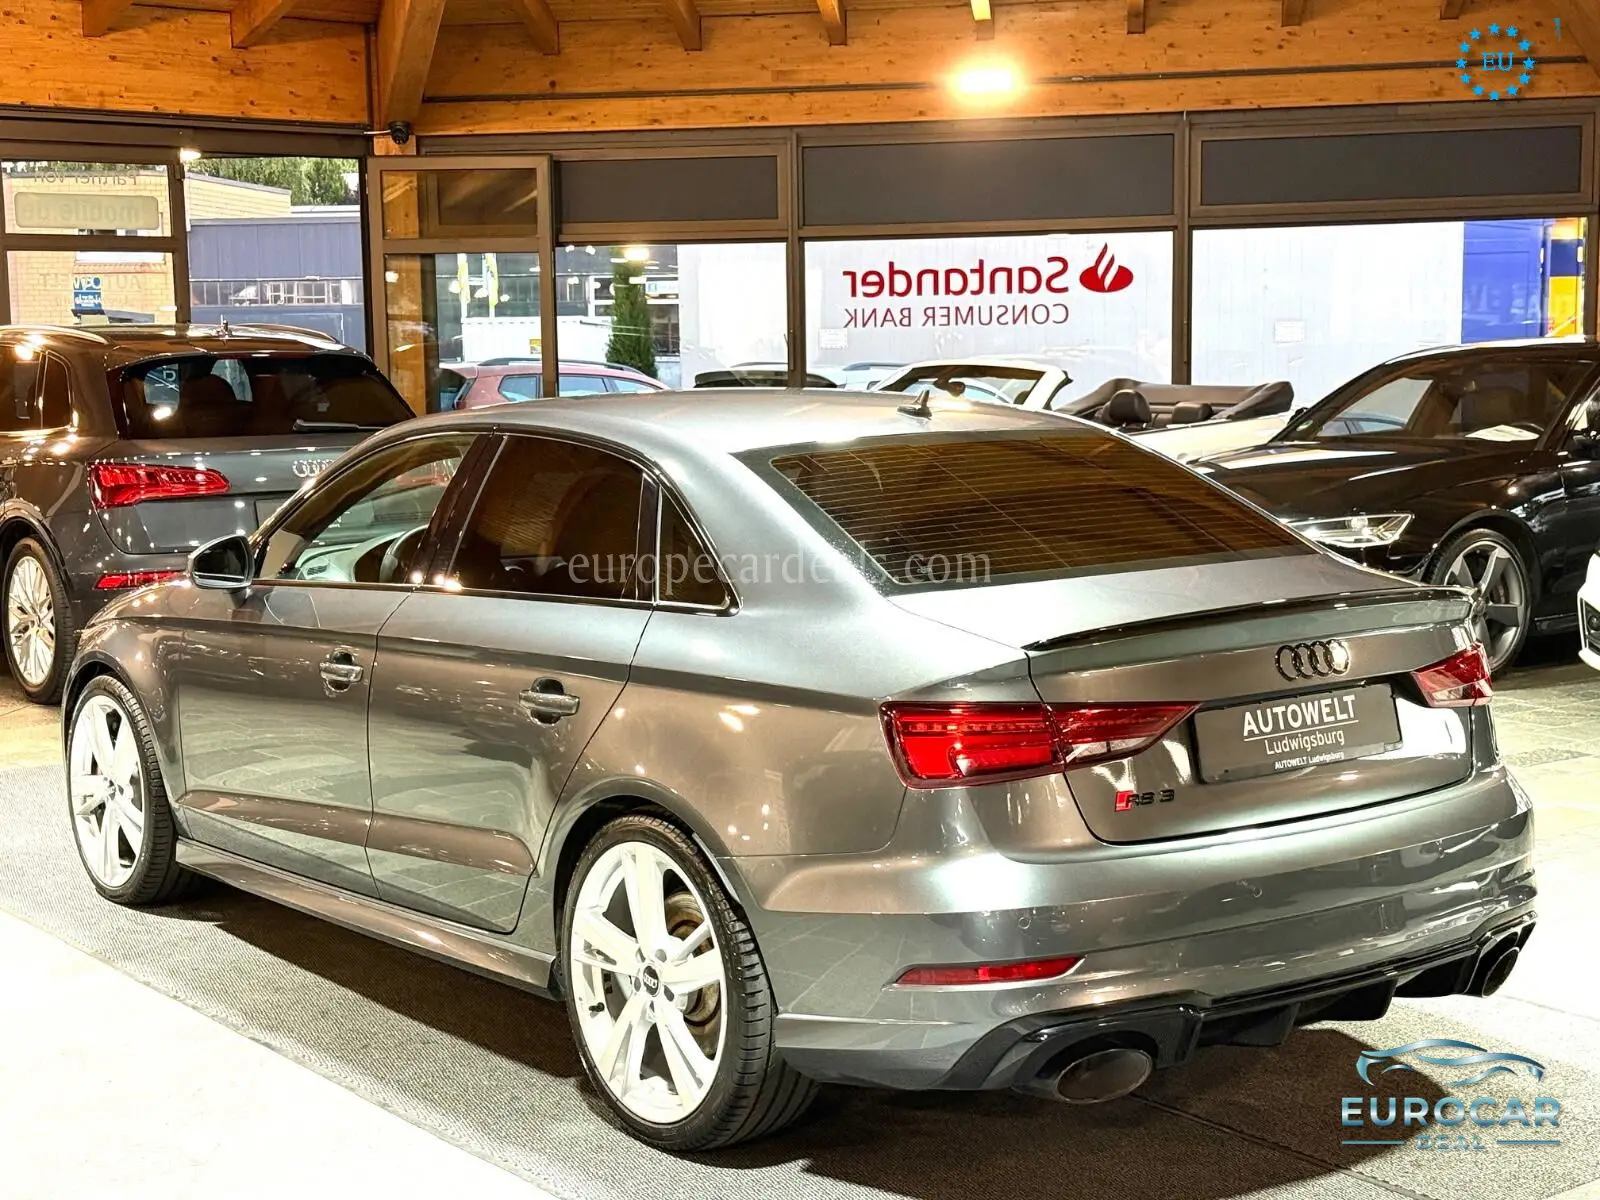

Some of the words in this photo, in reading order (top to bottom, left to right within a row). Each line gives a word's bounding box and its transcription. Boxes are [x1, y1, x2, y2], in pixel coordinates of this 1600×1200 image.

[1243, 694, 1356, 737] AUTOWELT
[1264, 729, 1345, 755] Ludwigsburg
[1274, 756, 1308, 770] AUTOWELT
[1308, 750, 1345, 765] Ludwigsburg
